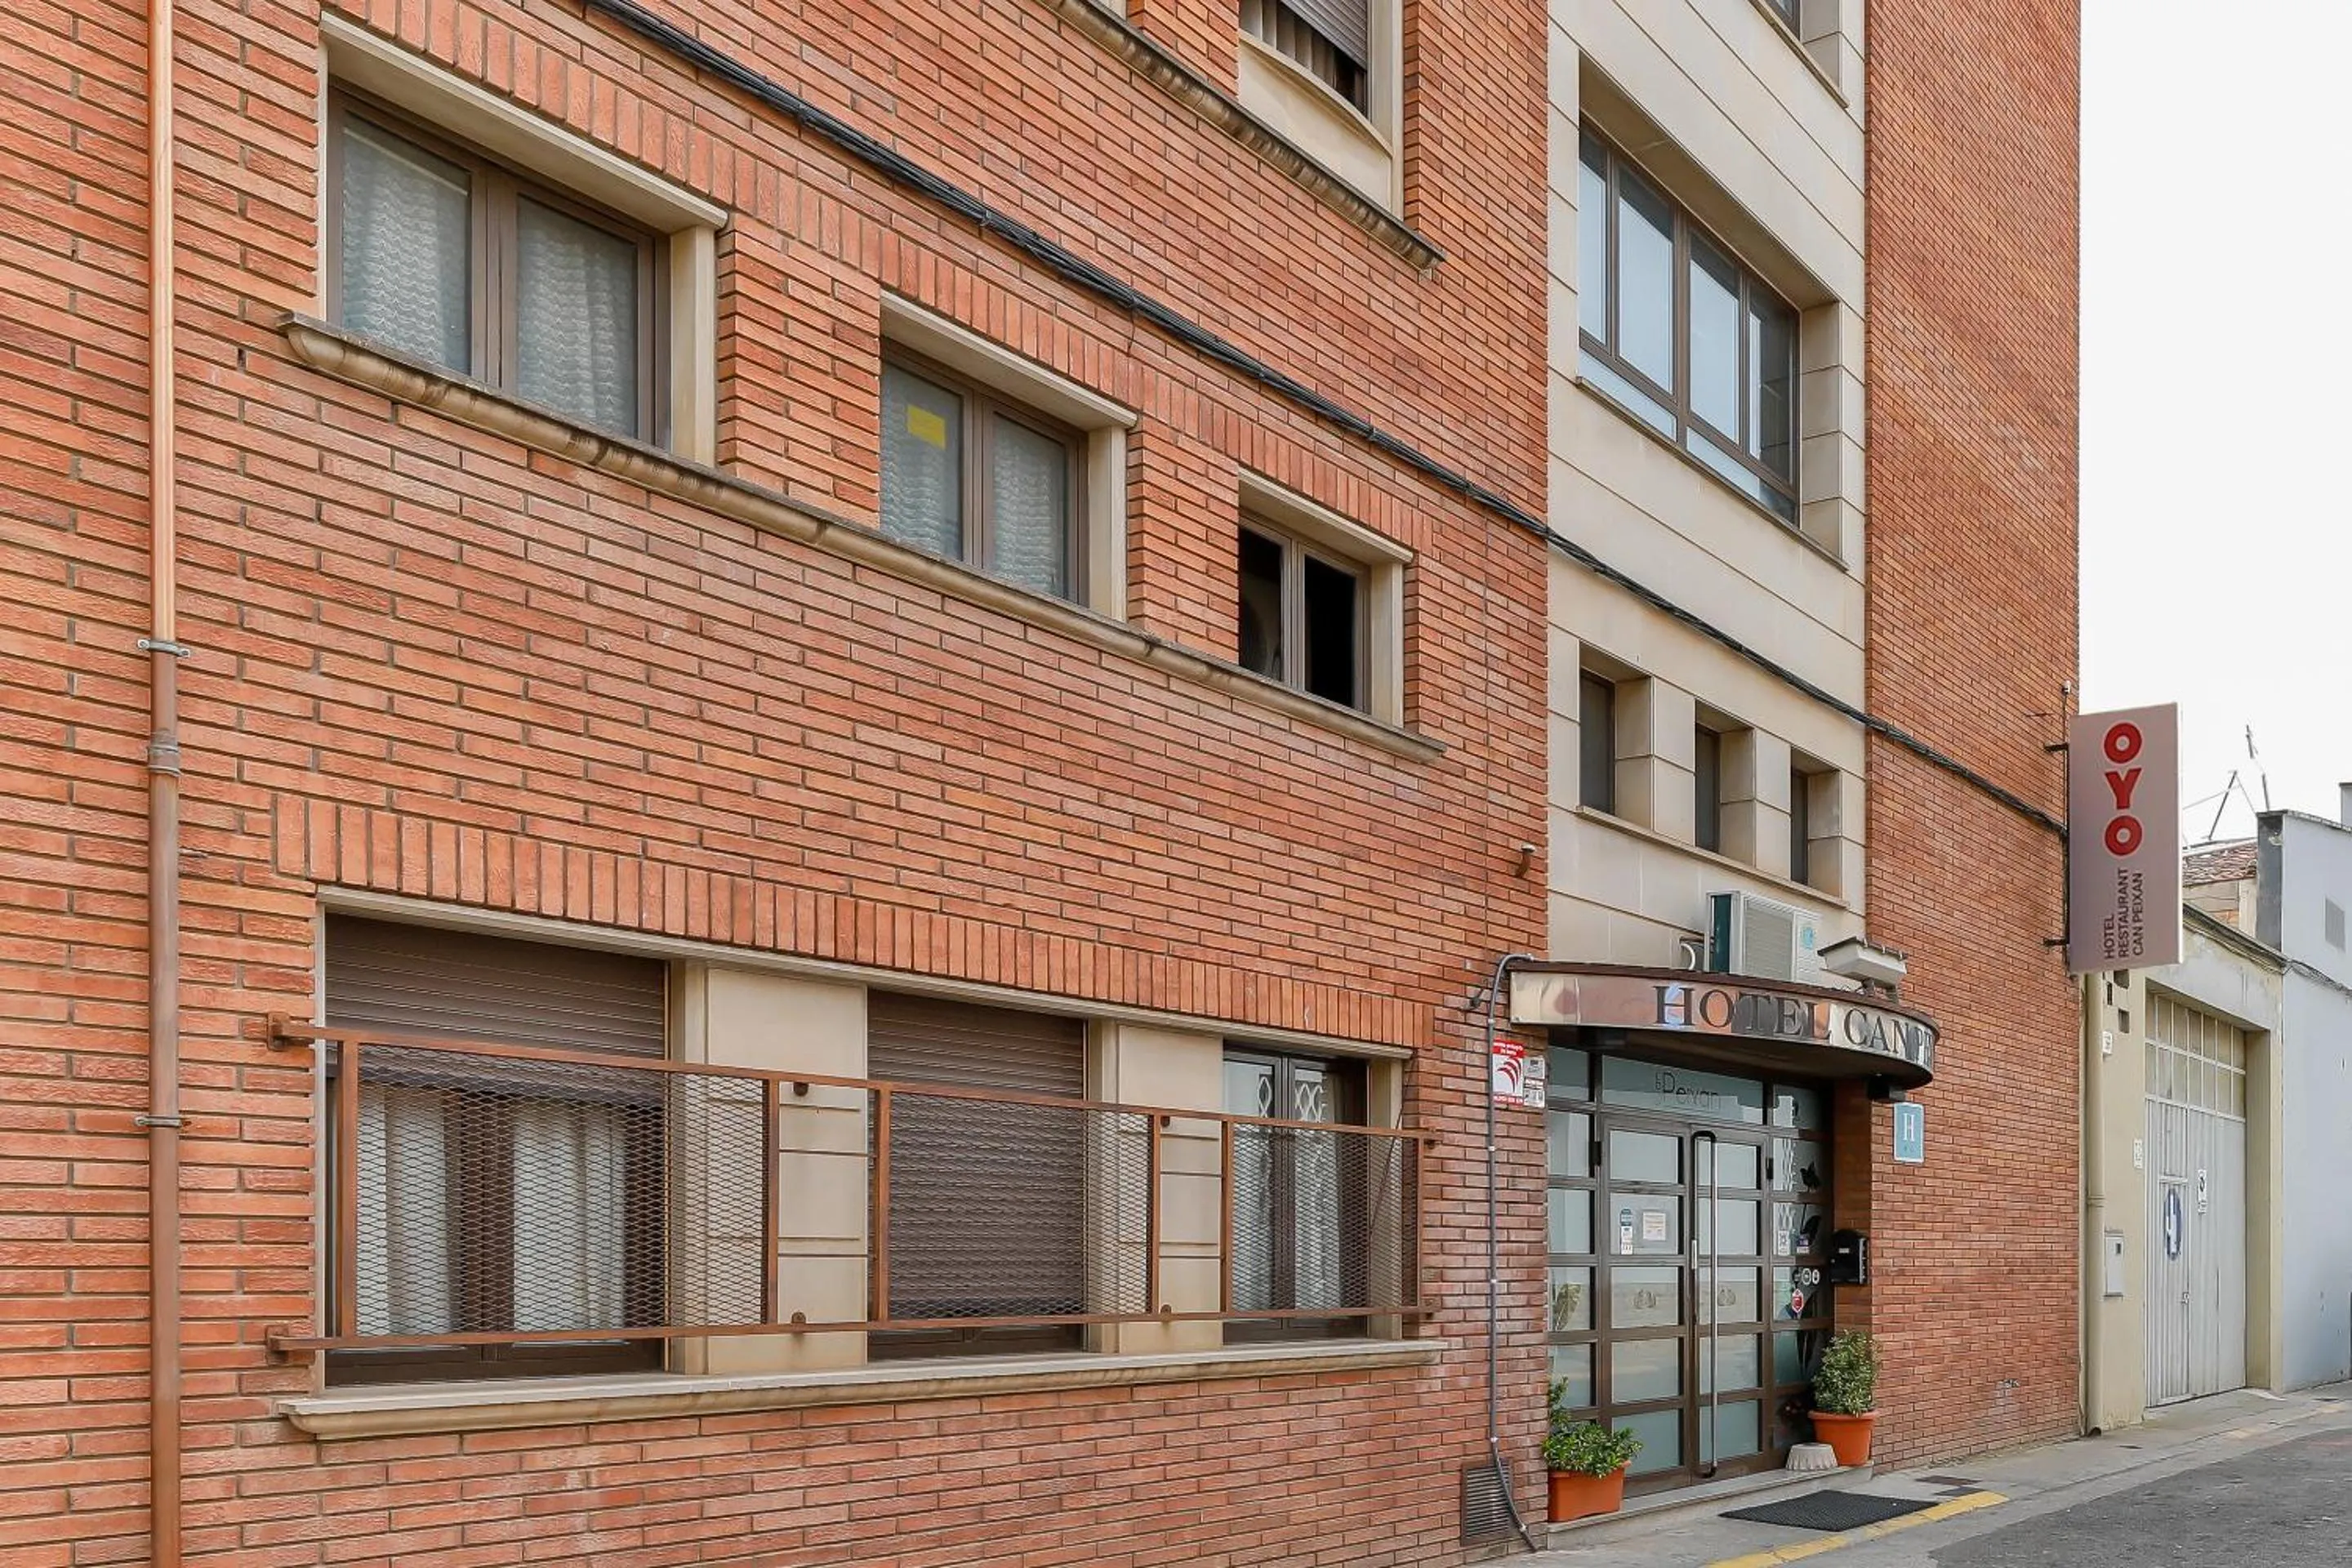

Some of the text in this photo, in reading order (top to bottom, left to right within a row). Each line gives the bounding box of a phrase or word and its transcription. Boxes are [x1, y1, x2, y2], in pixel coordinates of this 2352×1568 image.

[2104, 722, 2143, 857] OYO
[2104, 913, 2115, 960] HOTEL
[2118, 867, 2129, 958] RESTAURANT
[2132, 872, 2144, 956] CAN PEIXAN
[1653, 985, 1831, 1040] HOTEL
[1844, 1008, 1910, 1060] CAN
[1902, 1112, 1915, 1142] H
